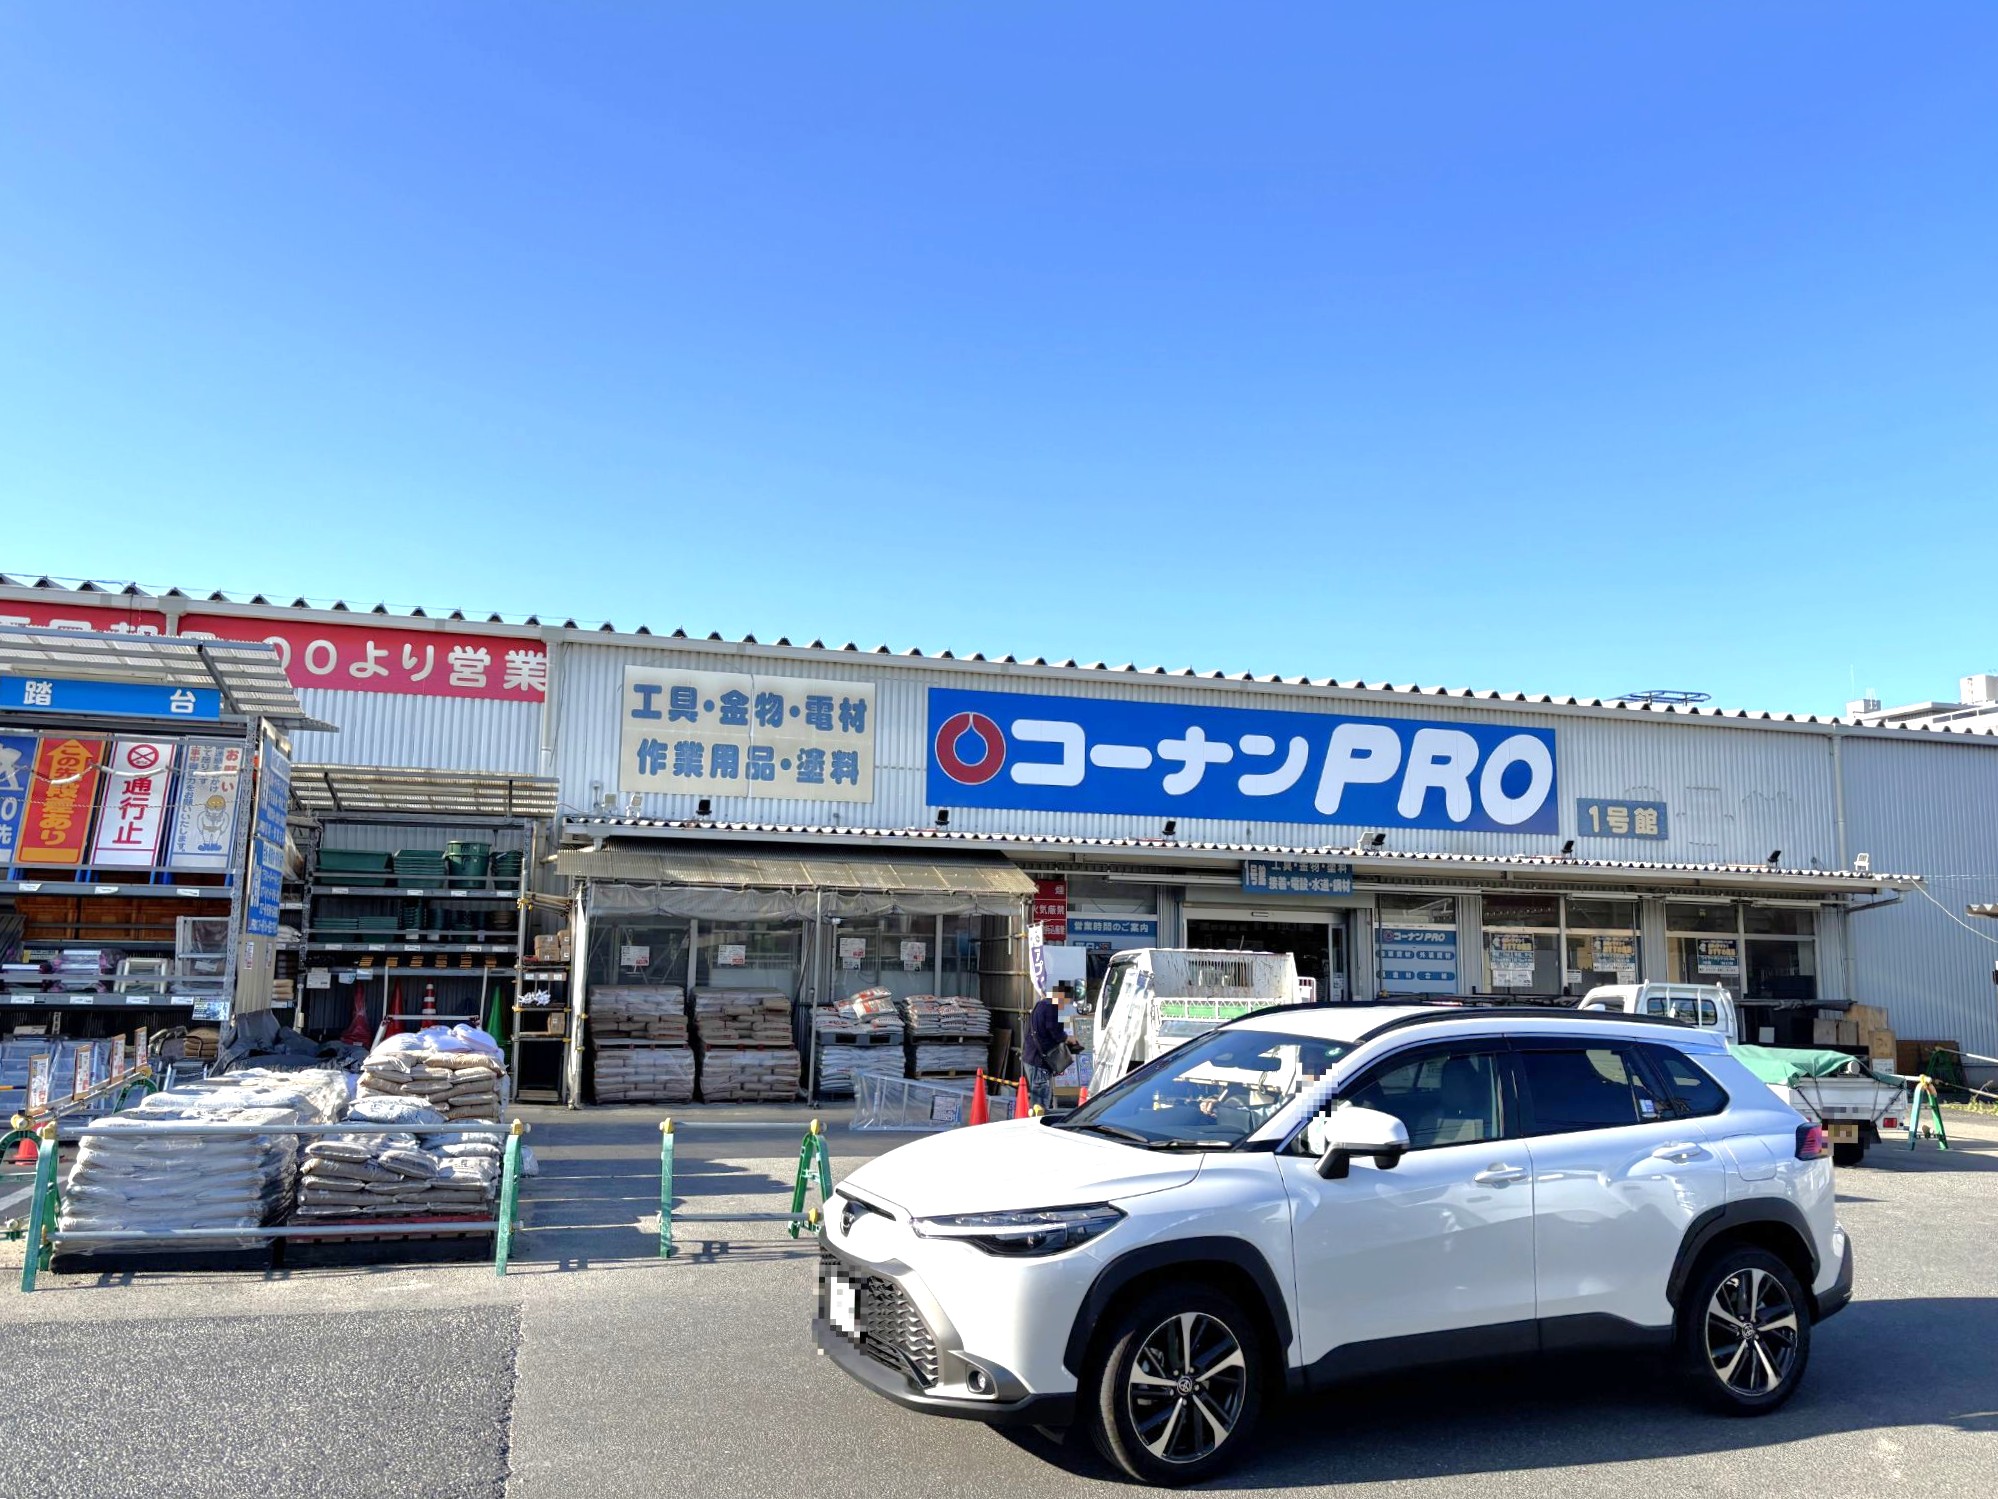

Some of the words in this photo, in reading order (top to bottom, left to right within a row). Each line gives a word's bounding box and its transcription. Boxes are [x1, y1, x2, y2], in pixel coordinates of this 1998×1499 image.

[631, 683, 867, 734] 工具・金物・電材
[636, 738, 860, 786] 作業用品・塗料
[111, 777, 153, 845] 通行止
[1588, 805, 1659, 835] 1号館
[1074, 921, 1149, 933] 営業時間のご案内
